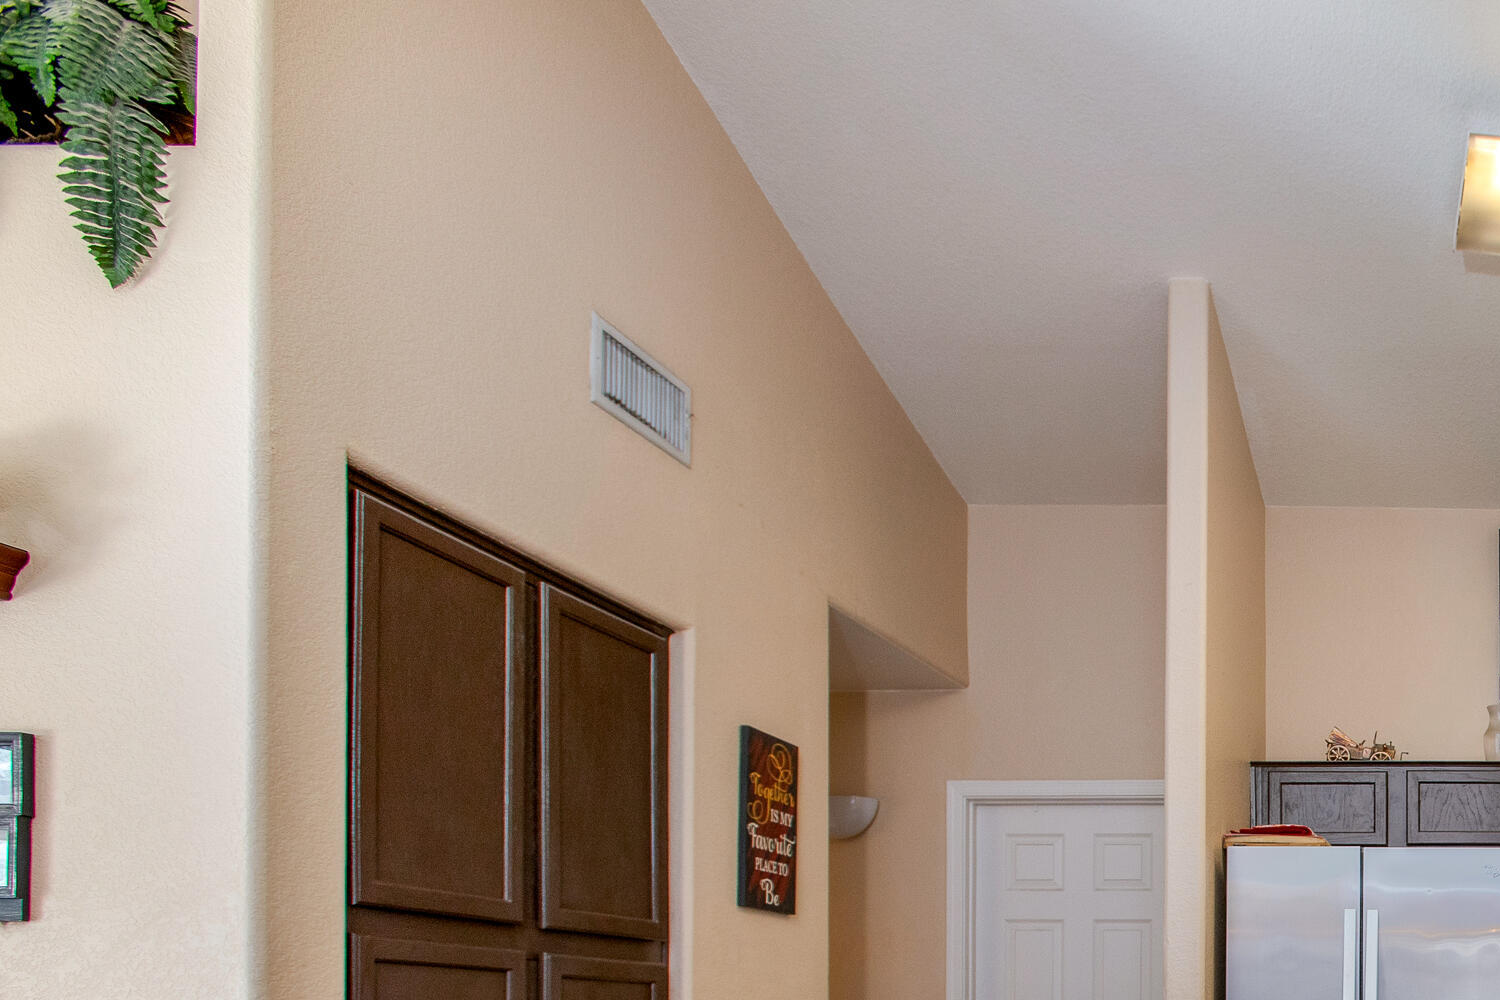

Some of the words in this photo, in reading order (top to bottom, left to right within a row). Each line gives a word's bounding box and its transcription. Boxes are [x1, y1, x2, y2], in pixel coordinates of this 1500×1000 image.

[770, 808, 779, 823] IS
[780, 811, 794, 827] MY
[747, 822, 796, 857] Favorite
[755, 857, 778, 875] PLACE
[778, 862, 789, 877] TO
[760, 878, 780, 906] Be
